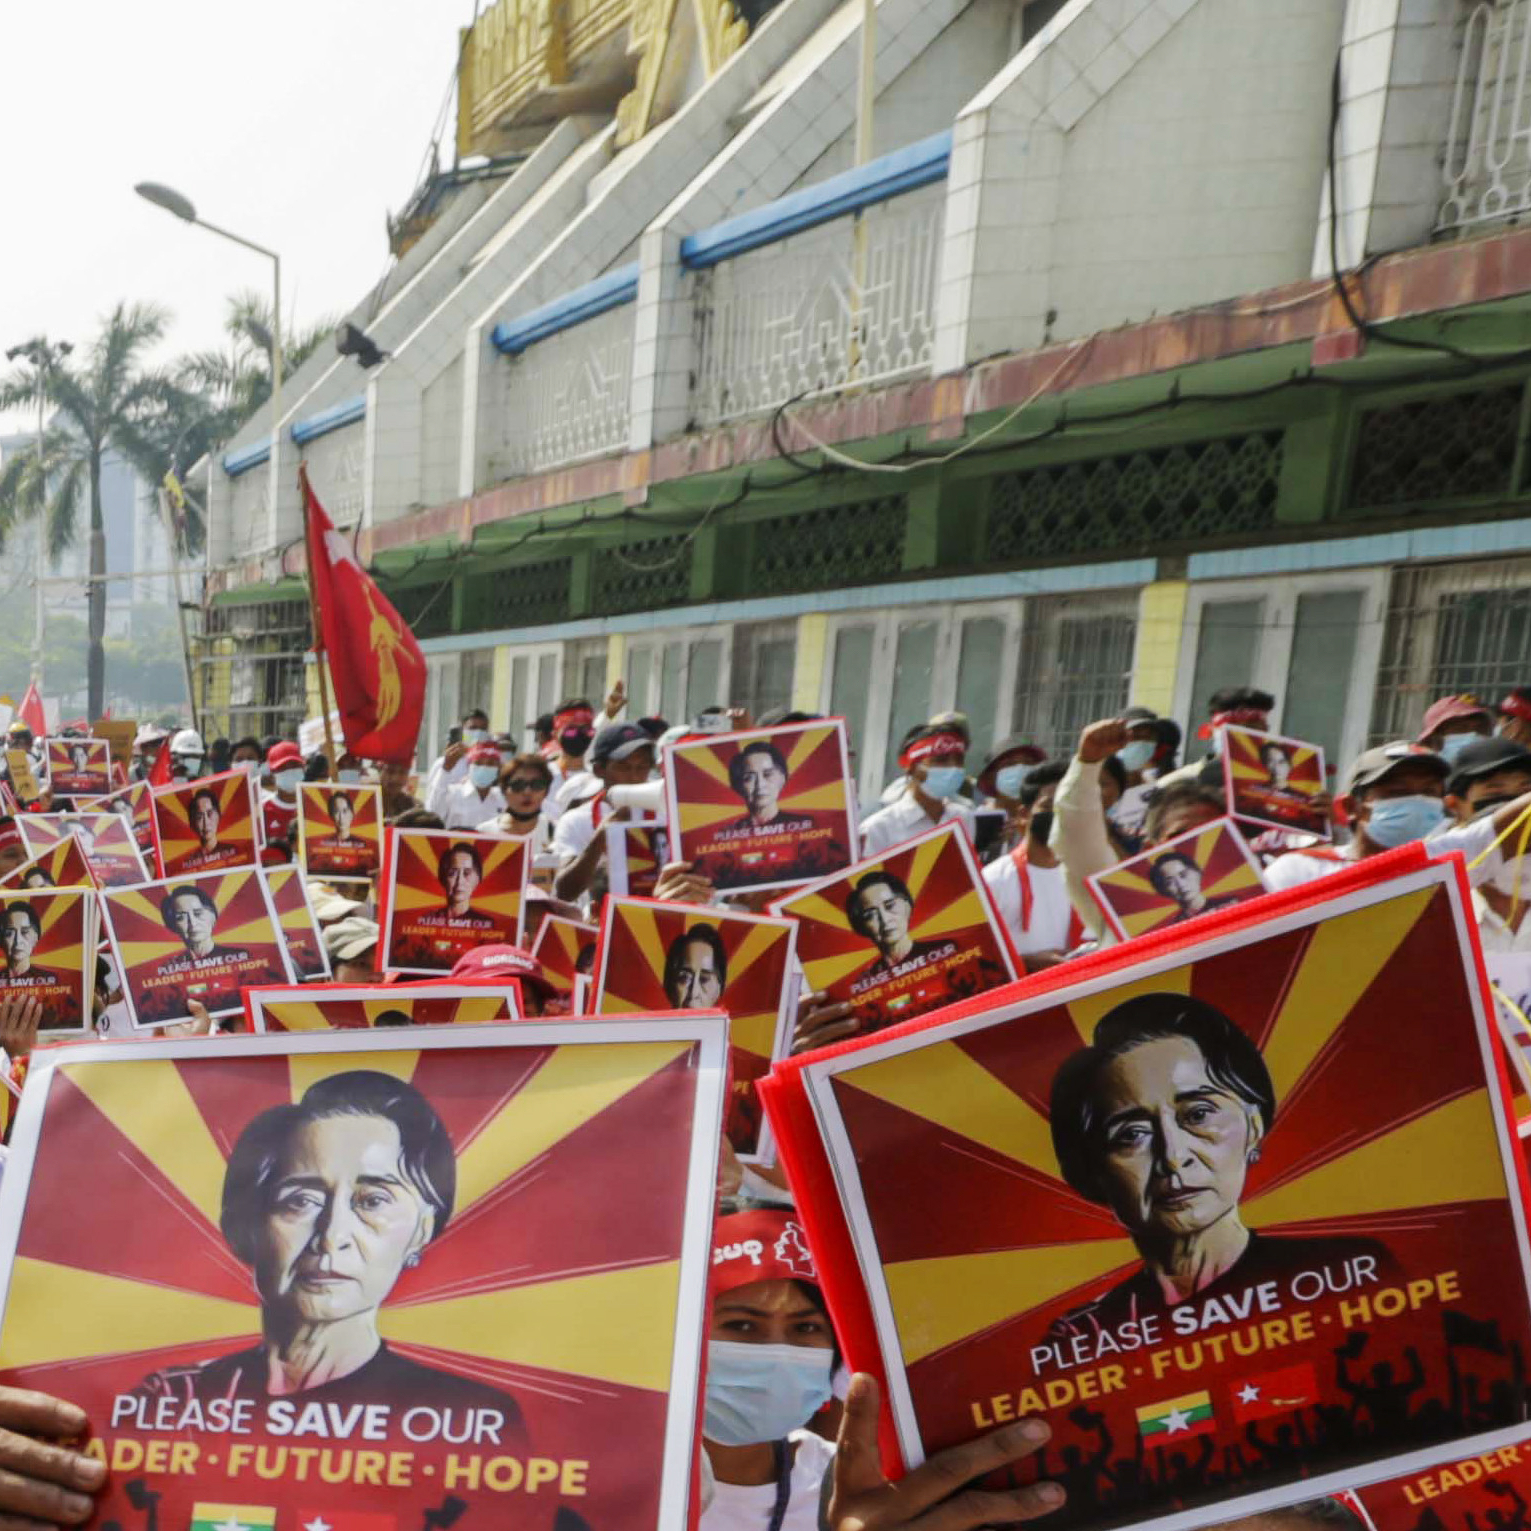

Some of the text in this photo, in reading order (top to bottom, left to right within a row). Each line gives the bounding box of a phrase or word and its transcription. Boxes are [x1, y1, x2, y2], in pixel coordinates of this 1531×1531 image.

[695, 827, 834, 853] LEADER FUTURE HOPE
[713, 820, 813, 841] PLEASE SAVE OUR
[141, 957, 270, 988] LEADER FUTURE HOPE
[157, 952, 249, 976] PLEASE SAVE OUR
[850, 942, 955, 995] PLEASE SAVE OUR
[887, 961, 938, 991] FUTURE
[943, 946, 982, 970] HOPE
[1029, 1254, 1379, 1377] PLEASE SAVE OUR
[969, 1270, 1463, 1430] LEADER FUTURE HOPE
[110, 1394, 505, 1445] PLEASE SAVE OUR
[85, 1436, 592, 1496] ADER FUTURE HOPE
[1402, 1444, 1522, 1505] LEADER
